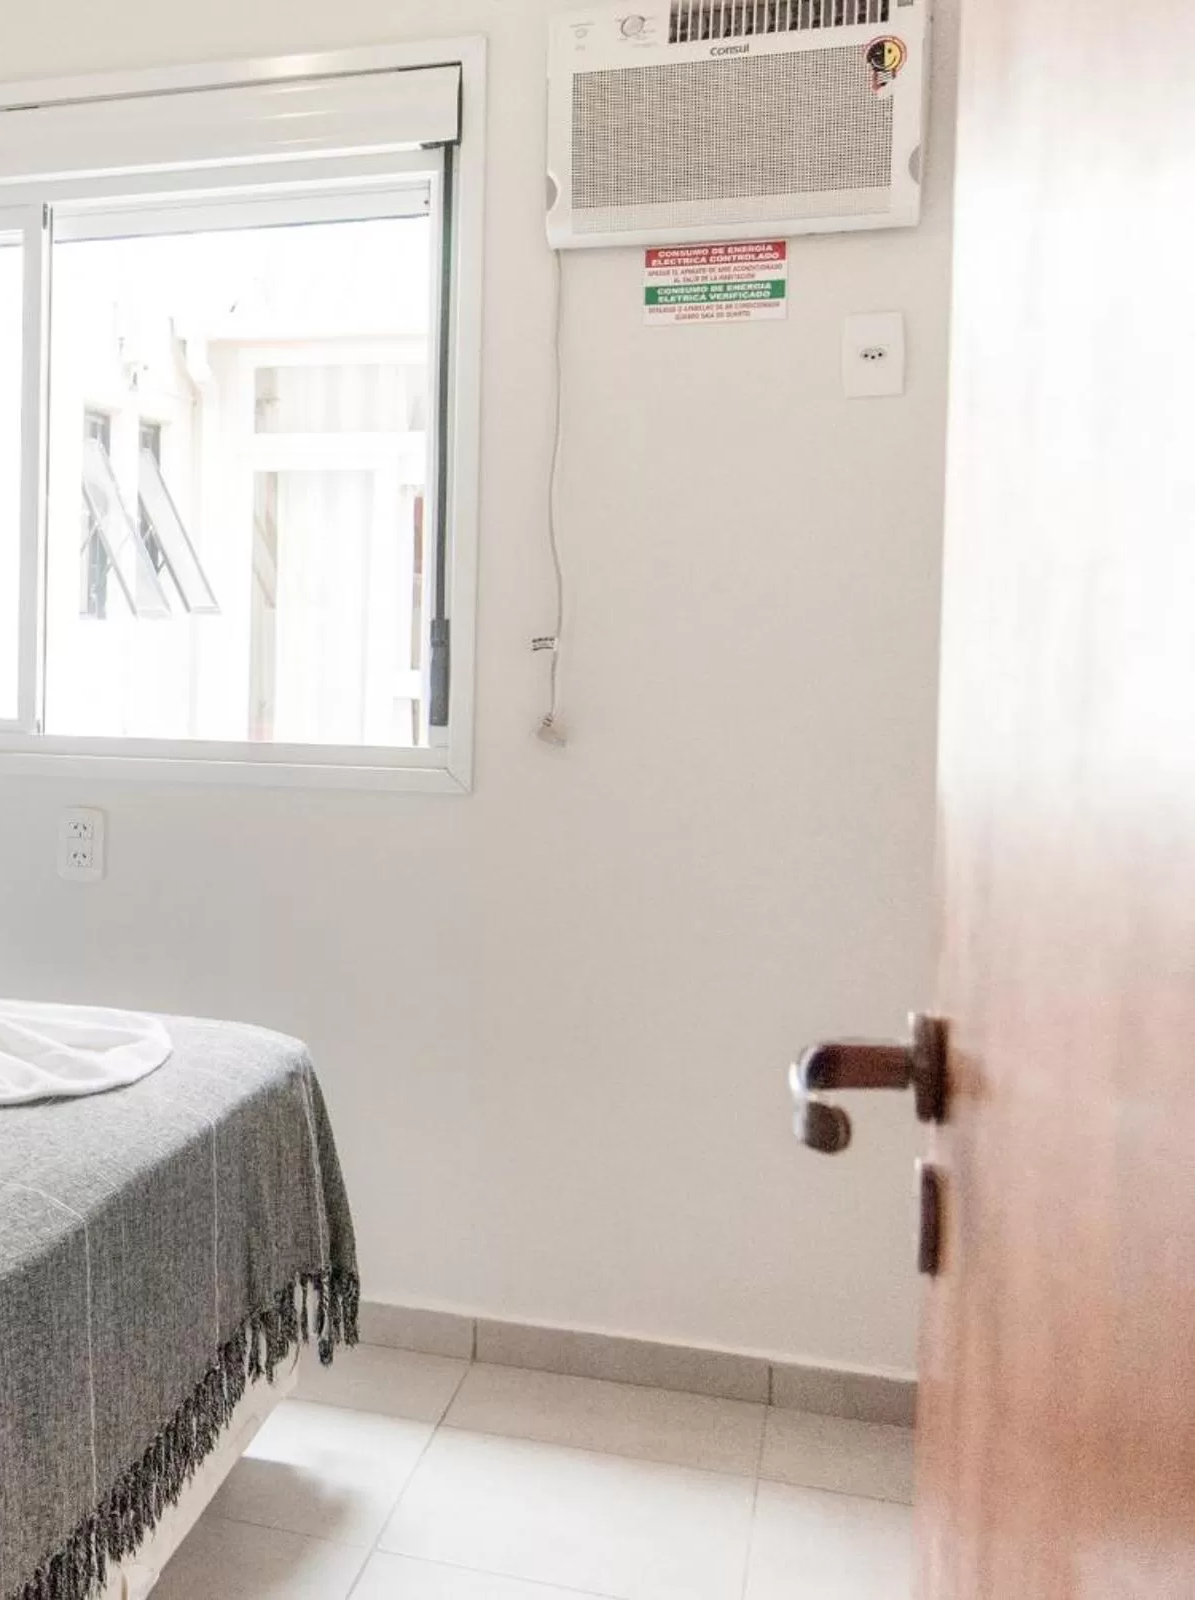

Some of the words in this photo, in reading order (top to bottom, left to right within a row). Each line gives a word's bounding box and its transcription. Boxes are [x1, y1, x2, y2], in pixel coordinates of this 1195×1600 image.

[657, 249, 709, 259] CONSUMO
[711, 247, 725, 255] DE
[709, 252, 780, 263] CONTROLADO
[657, 286, 708, 296] CONSUMO
[710, 285, 724, 293] DE
[709, 290, 771, 301] VERIFICADO
